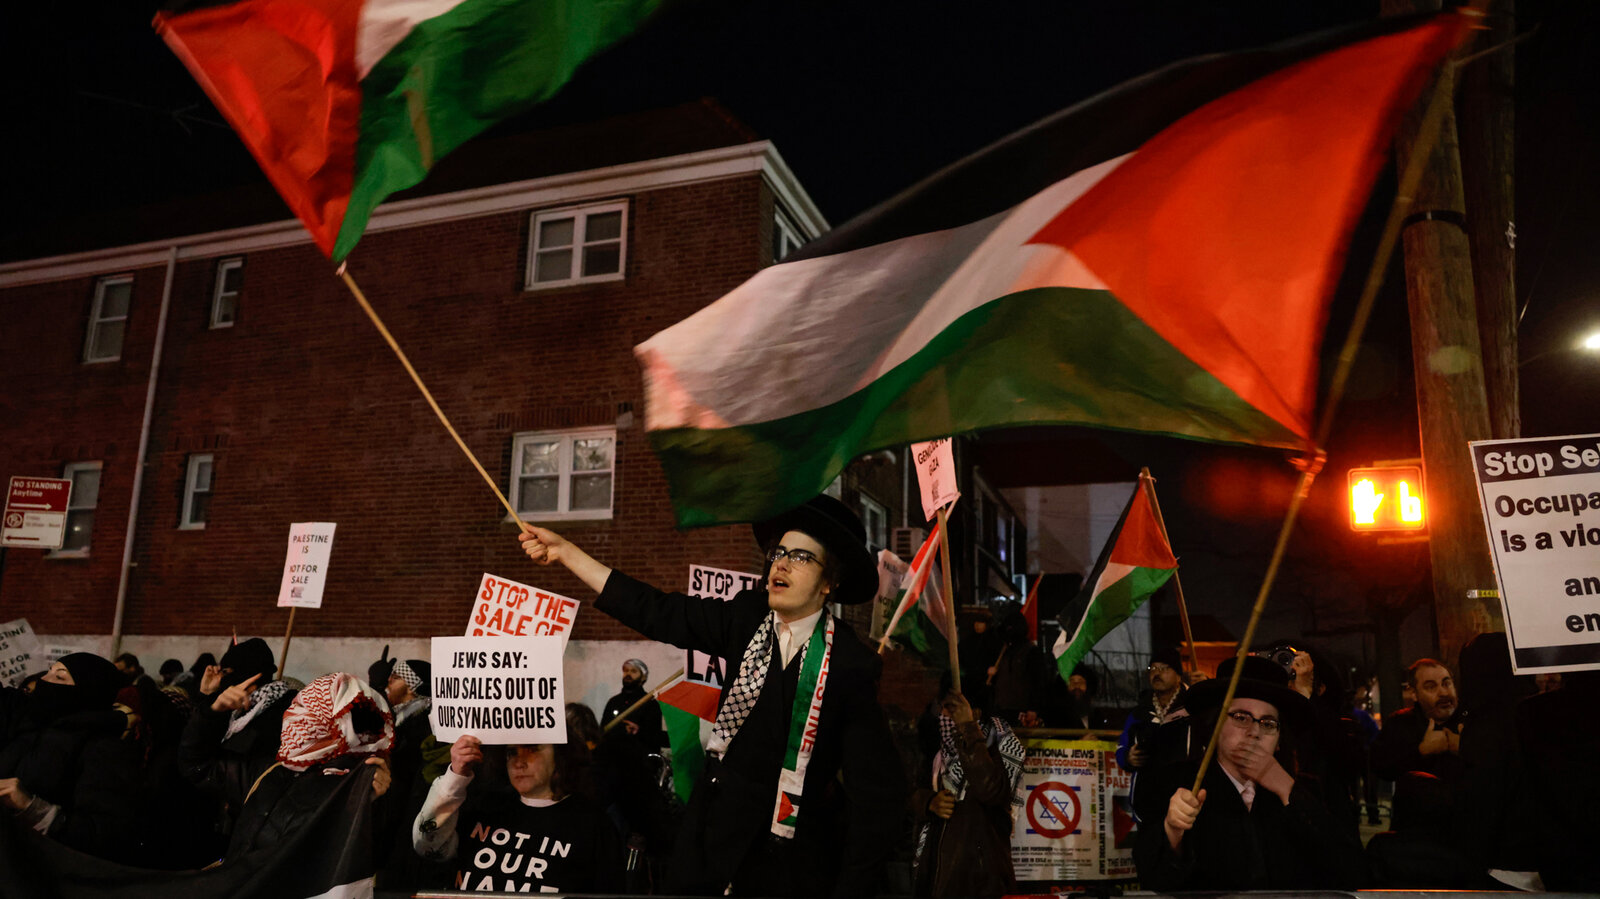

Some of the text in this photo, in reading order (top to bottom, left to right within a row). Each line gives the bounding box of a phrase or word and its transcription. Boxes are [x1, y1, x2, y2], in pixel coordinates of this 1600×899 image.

[1484, 451, 1554, 477] Stop
[12, 489, 43, 497] Anytime
[26, 482, 63, 490] STANDING
[1495, 491, 1600, 518] Occupa
[292, 534, 329, 543] PALESTINE
[1500, 529, 1527, 552] is
[1535, 532, 1553, 550] a
[302, 545, 309, 554] IS
[302, 565, 318, 573] FOR
[291, 576, 309, 584] SALE
[692, 568, 733, 596] STOP
[1564, 576, 1600, 596] an
[481, 577, 575, 625] STOP THE
[474, 603, 533, 637] SALE
[1565, 613, 1600, 633] en
[10, 653, 31, 665] FOR
[452, 651, 528, 669] JEWS SAY:
[1, 663, 26, 679] SALE
[435, 677, 557, 701] LAND SALES OUT OF
[438, 705, 556, 729] OUR SYNAGOGUES
[1071, 749, 1094, 759] JEWS
[1106, 777, 1129, 789] PALE
[470, 821, 572, 859] NOT IN
[473, 847, 548, 880] OUR
